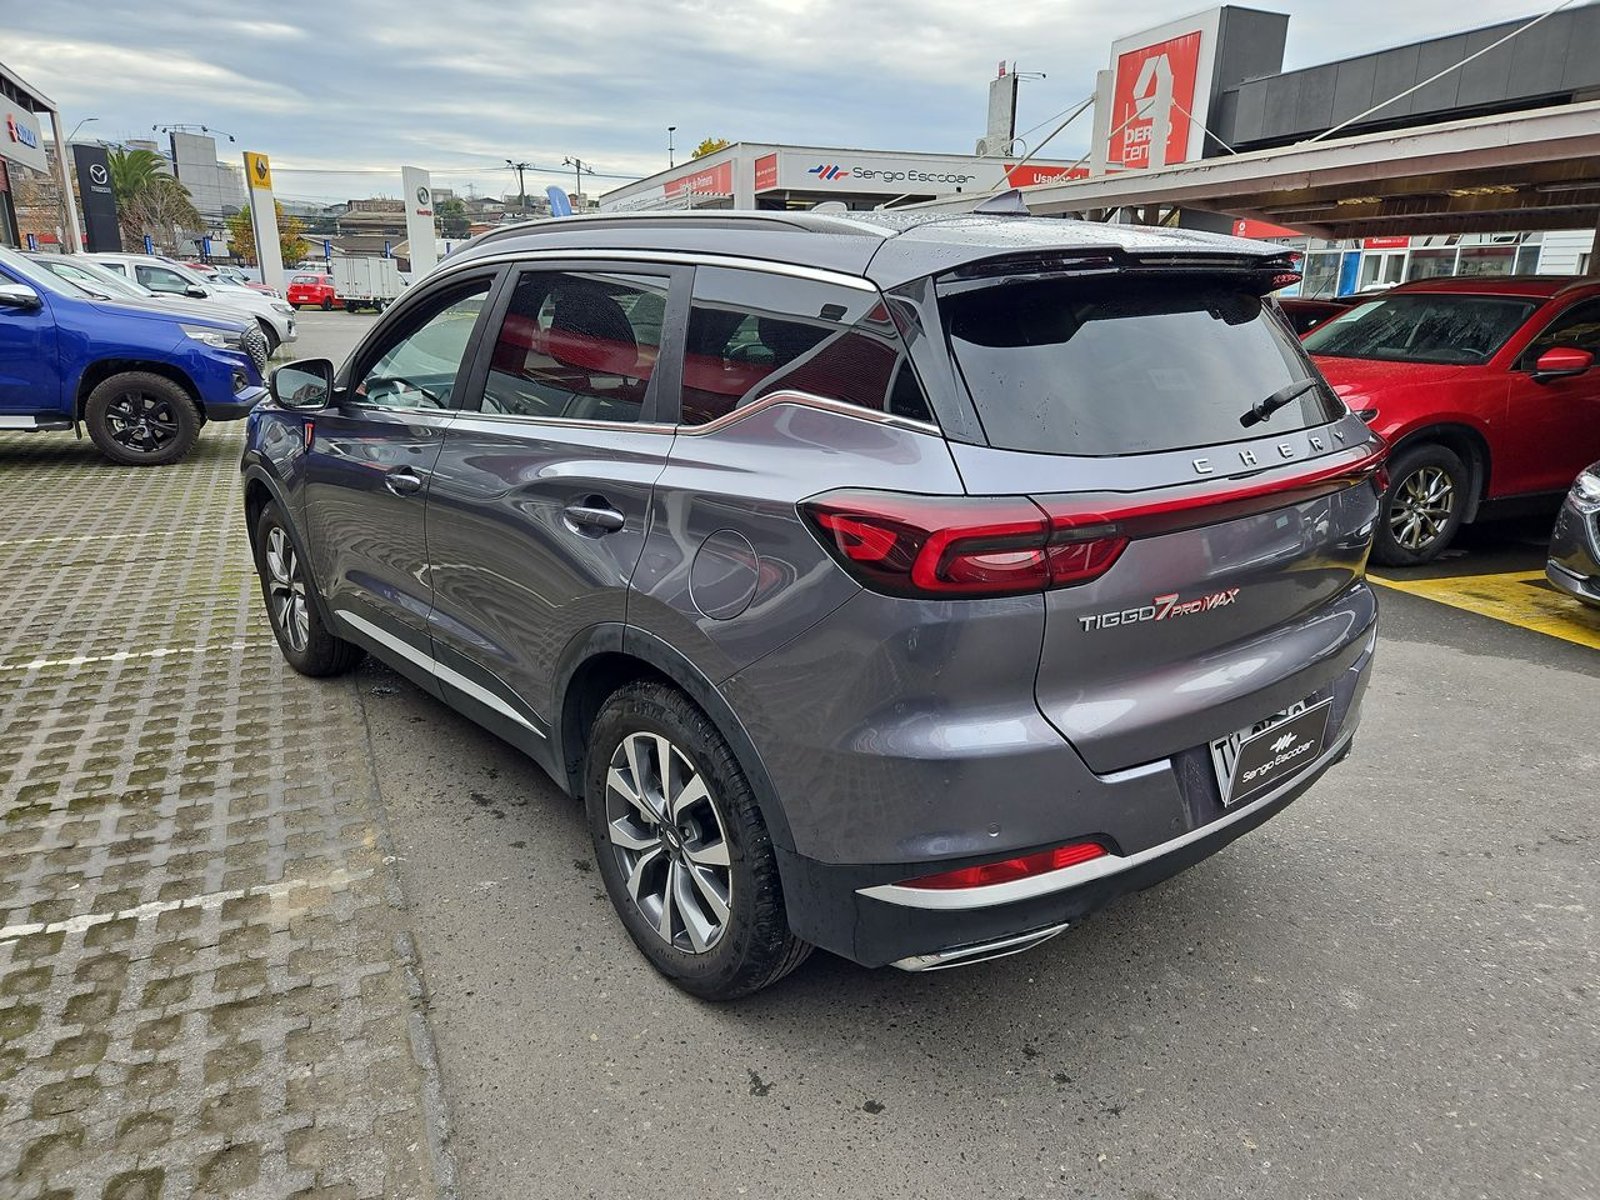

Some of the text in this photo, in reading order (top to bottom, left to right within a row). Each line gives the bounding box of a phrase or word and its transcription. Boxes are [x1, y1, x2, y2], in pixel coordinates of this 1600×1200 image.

[908, 169, 976, 184] Escobar
[1192, 432, 1345, 475] CHERY
[1078, 606, 1156, 632] TIGGO
[1275, 739, 1315, 765] Escobar
